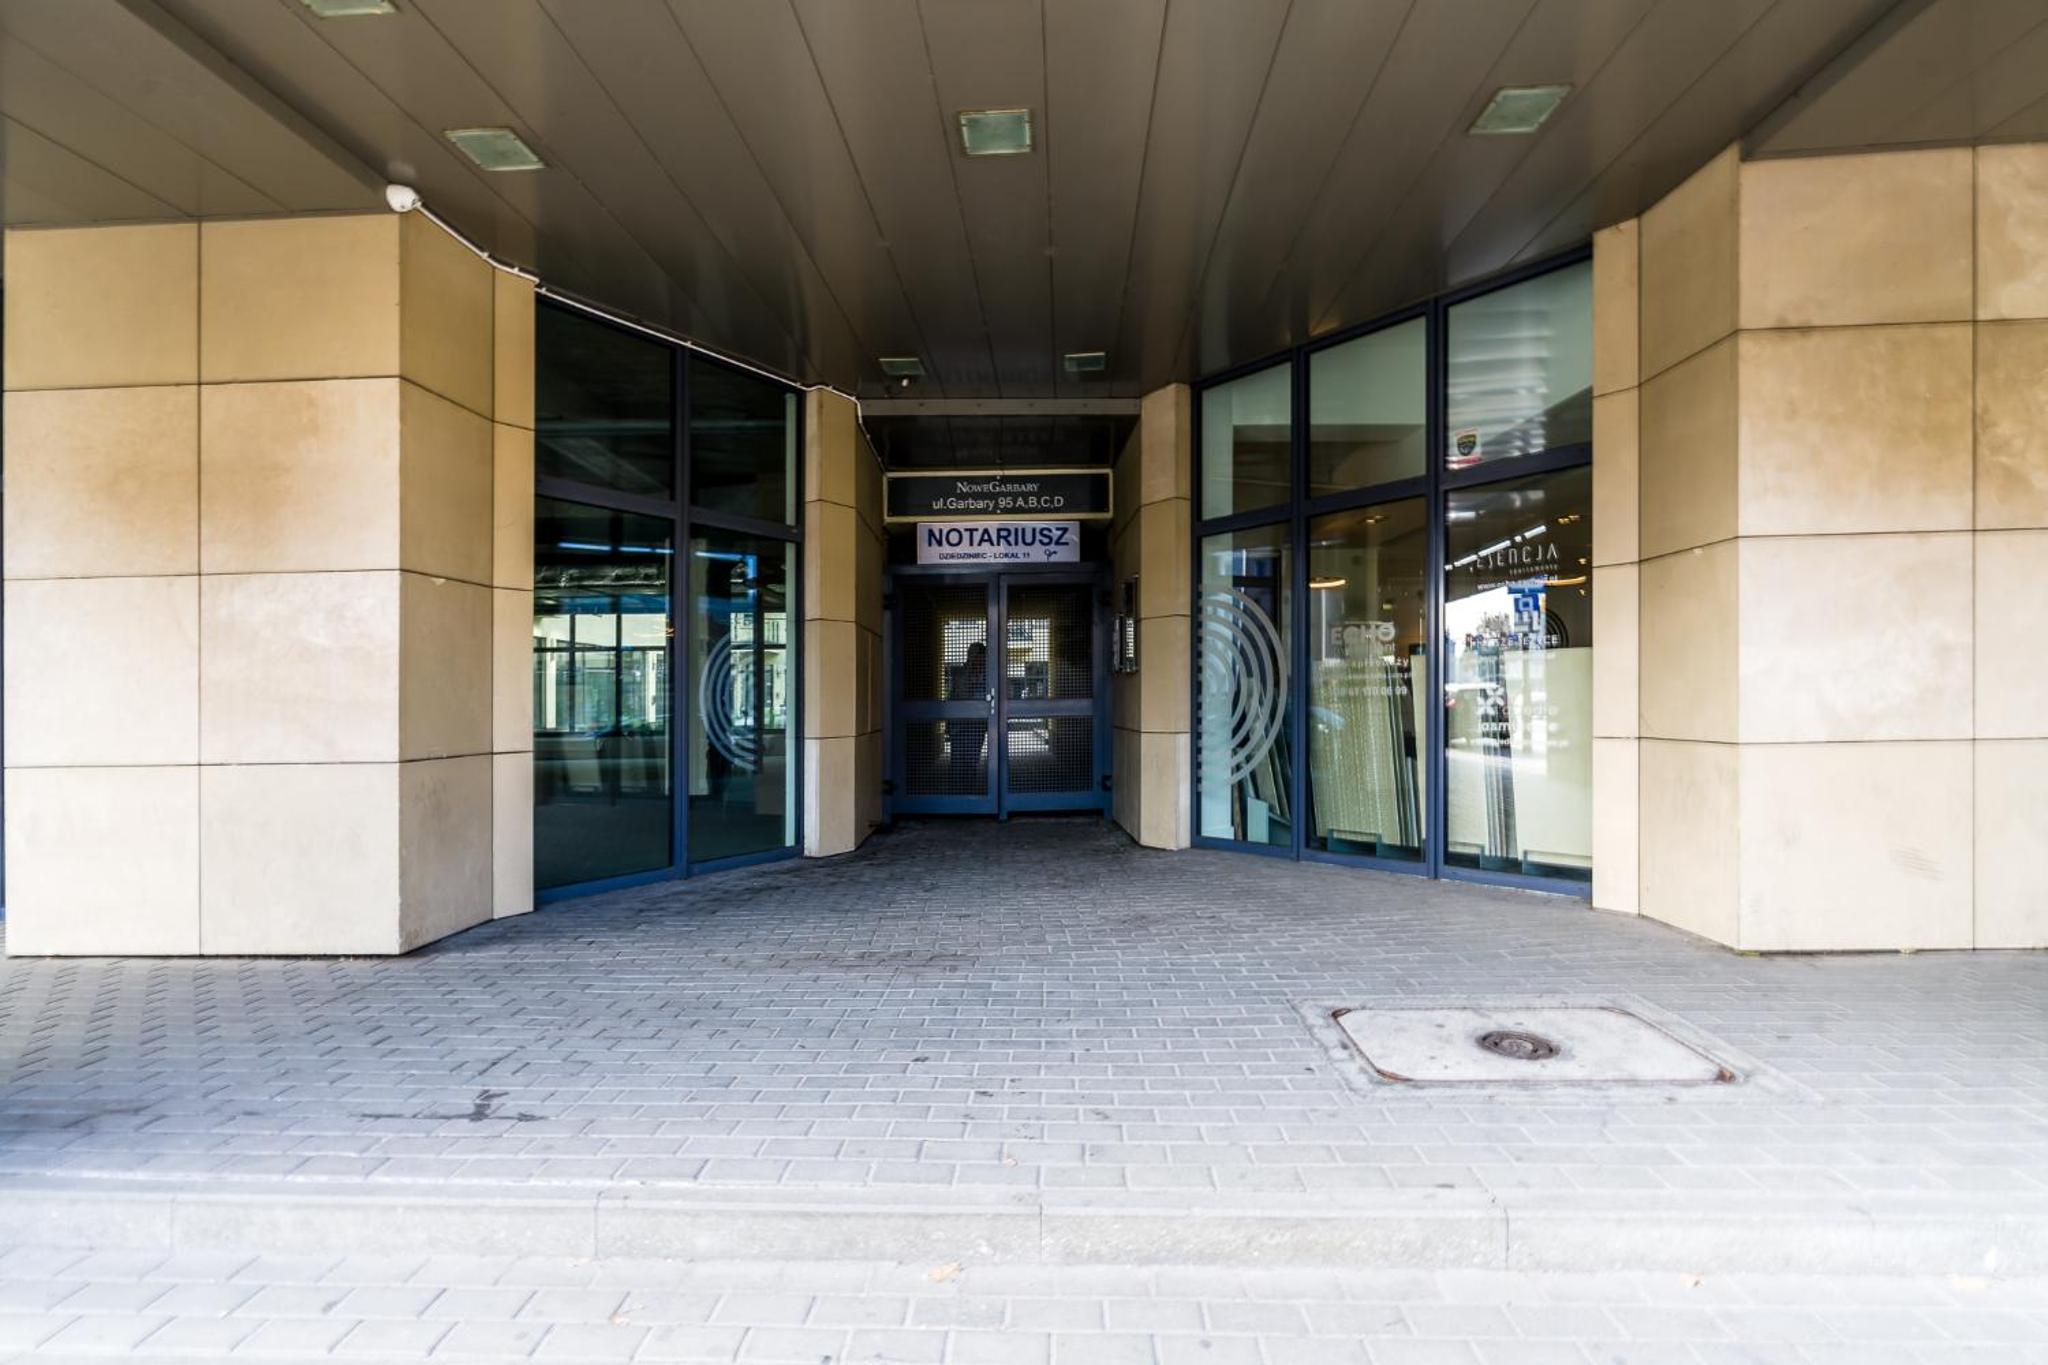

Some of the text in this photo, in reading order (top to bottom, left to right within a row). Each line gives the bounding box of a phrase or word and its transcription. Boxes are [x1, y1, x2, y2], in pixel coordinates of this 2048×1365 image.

[997, 496, 1014, 509] 95
[927, 527, 1070, 547] NOTARIUSZ
[938, 551, 988, 560] DZIEDZINIEC
[993, 551, 1020, 559] LOKAL
